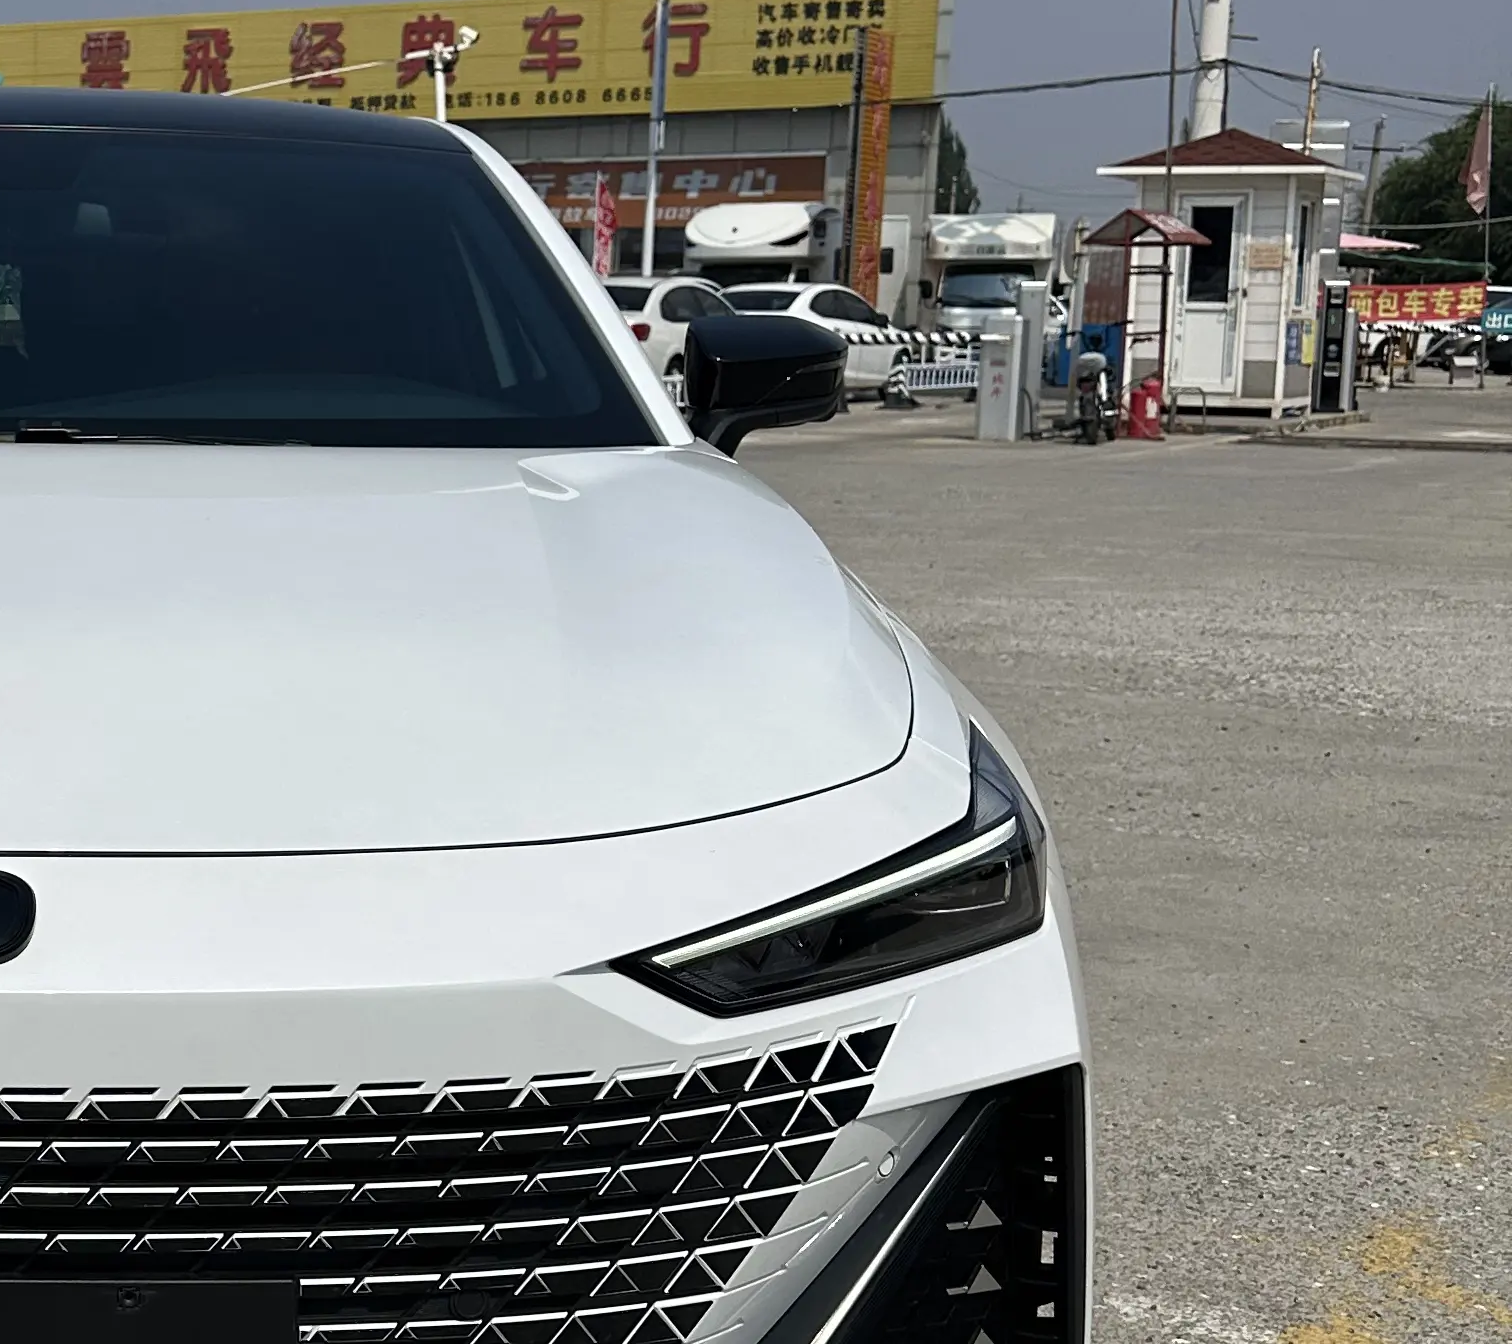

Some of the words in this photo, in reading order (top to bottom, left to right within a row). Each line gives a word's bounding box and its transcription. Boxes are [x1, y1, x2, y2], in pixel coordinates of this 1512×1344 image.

[1350, 285, 1485, 319] 面包车专卖
